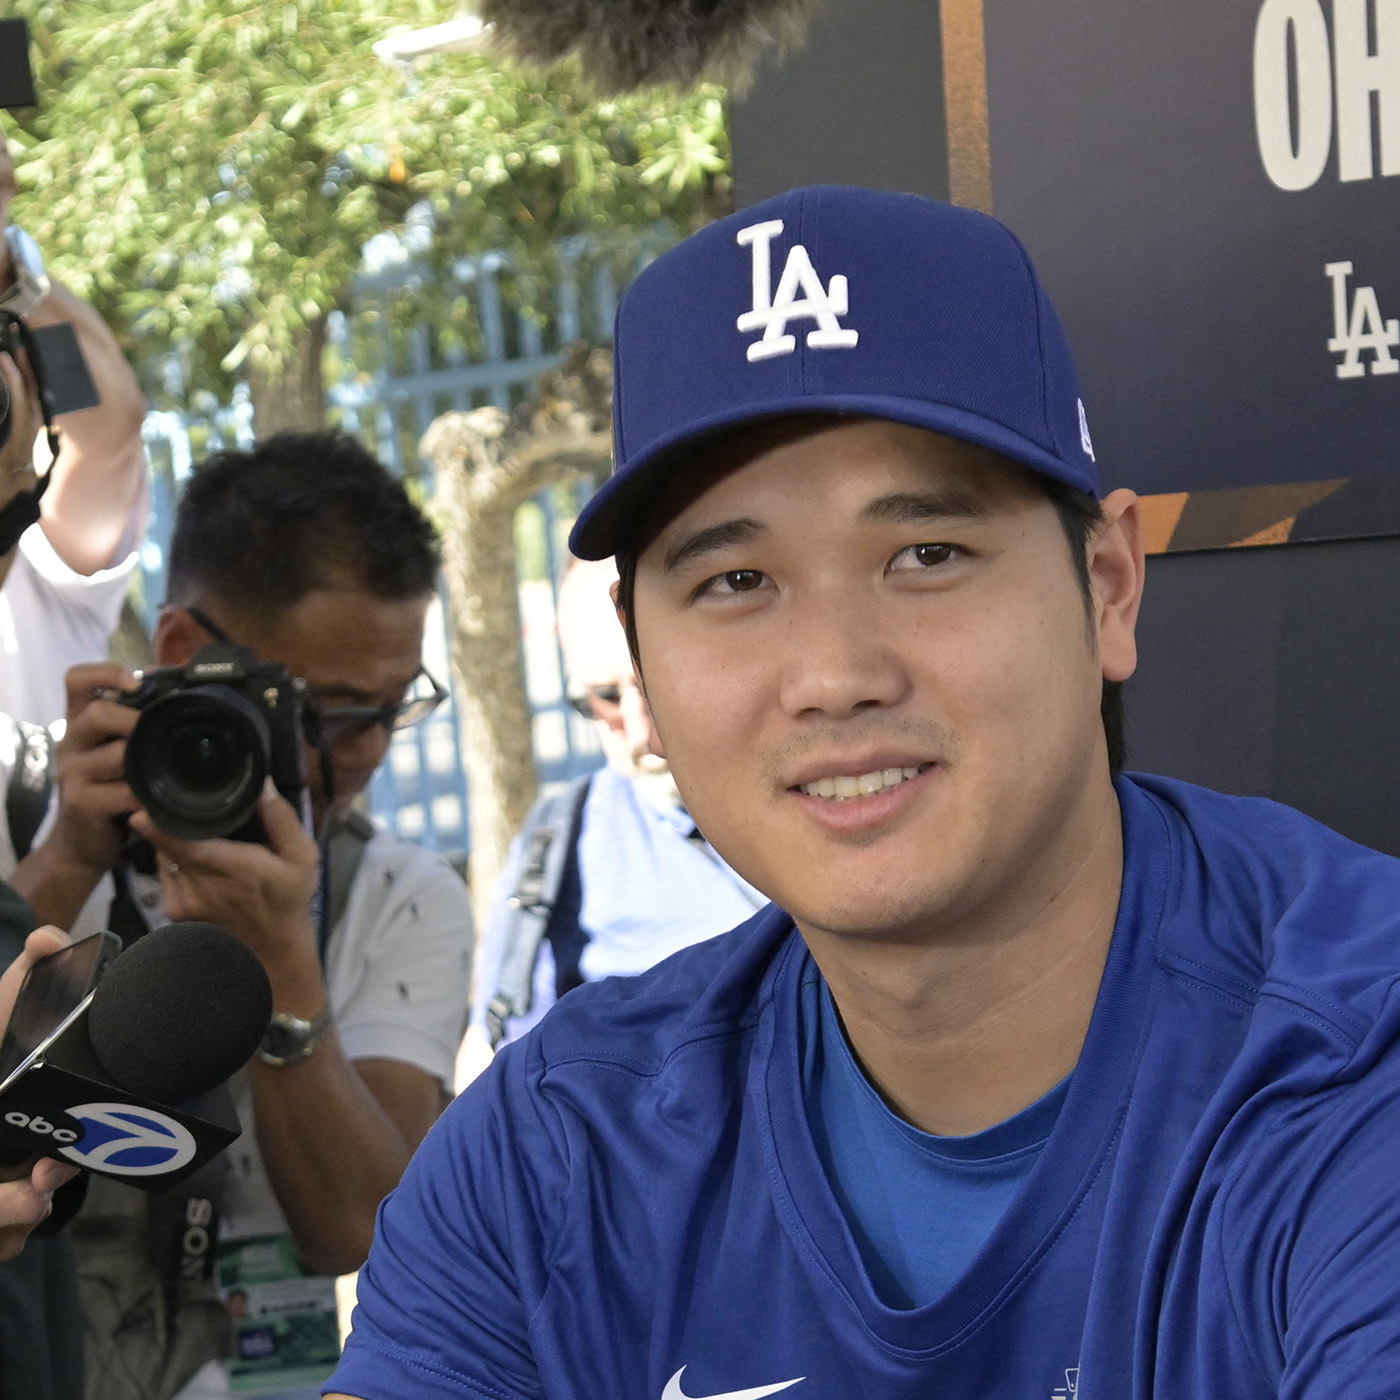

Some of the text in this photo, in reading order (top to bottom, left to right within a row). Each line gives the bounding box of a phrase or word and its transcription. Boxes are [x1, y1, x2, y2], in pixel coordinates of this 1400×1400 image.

[736, 219, 859, 362] LA
[1324, 260, 1400, 379] LA
[4, 1111, 78, 1142] abc
